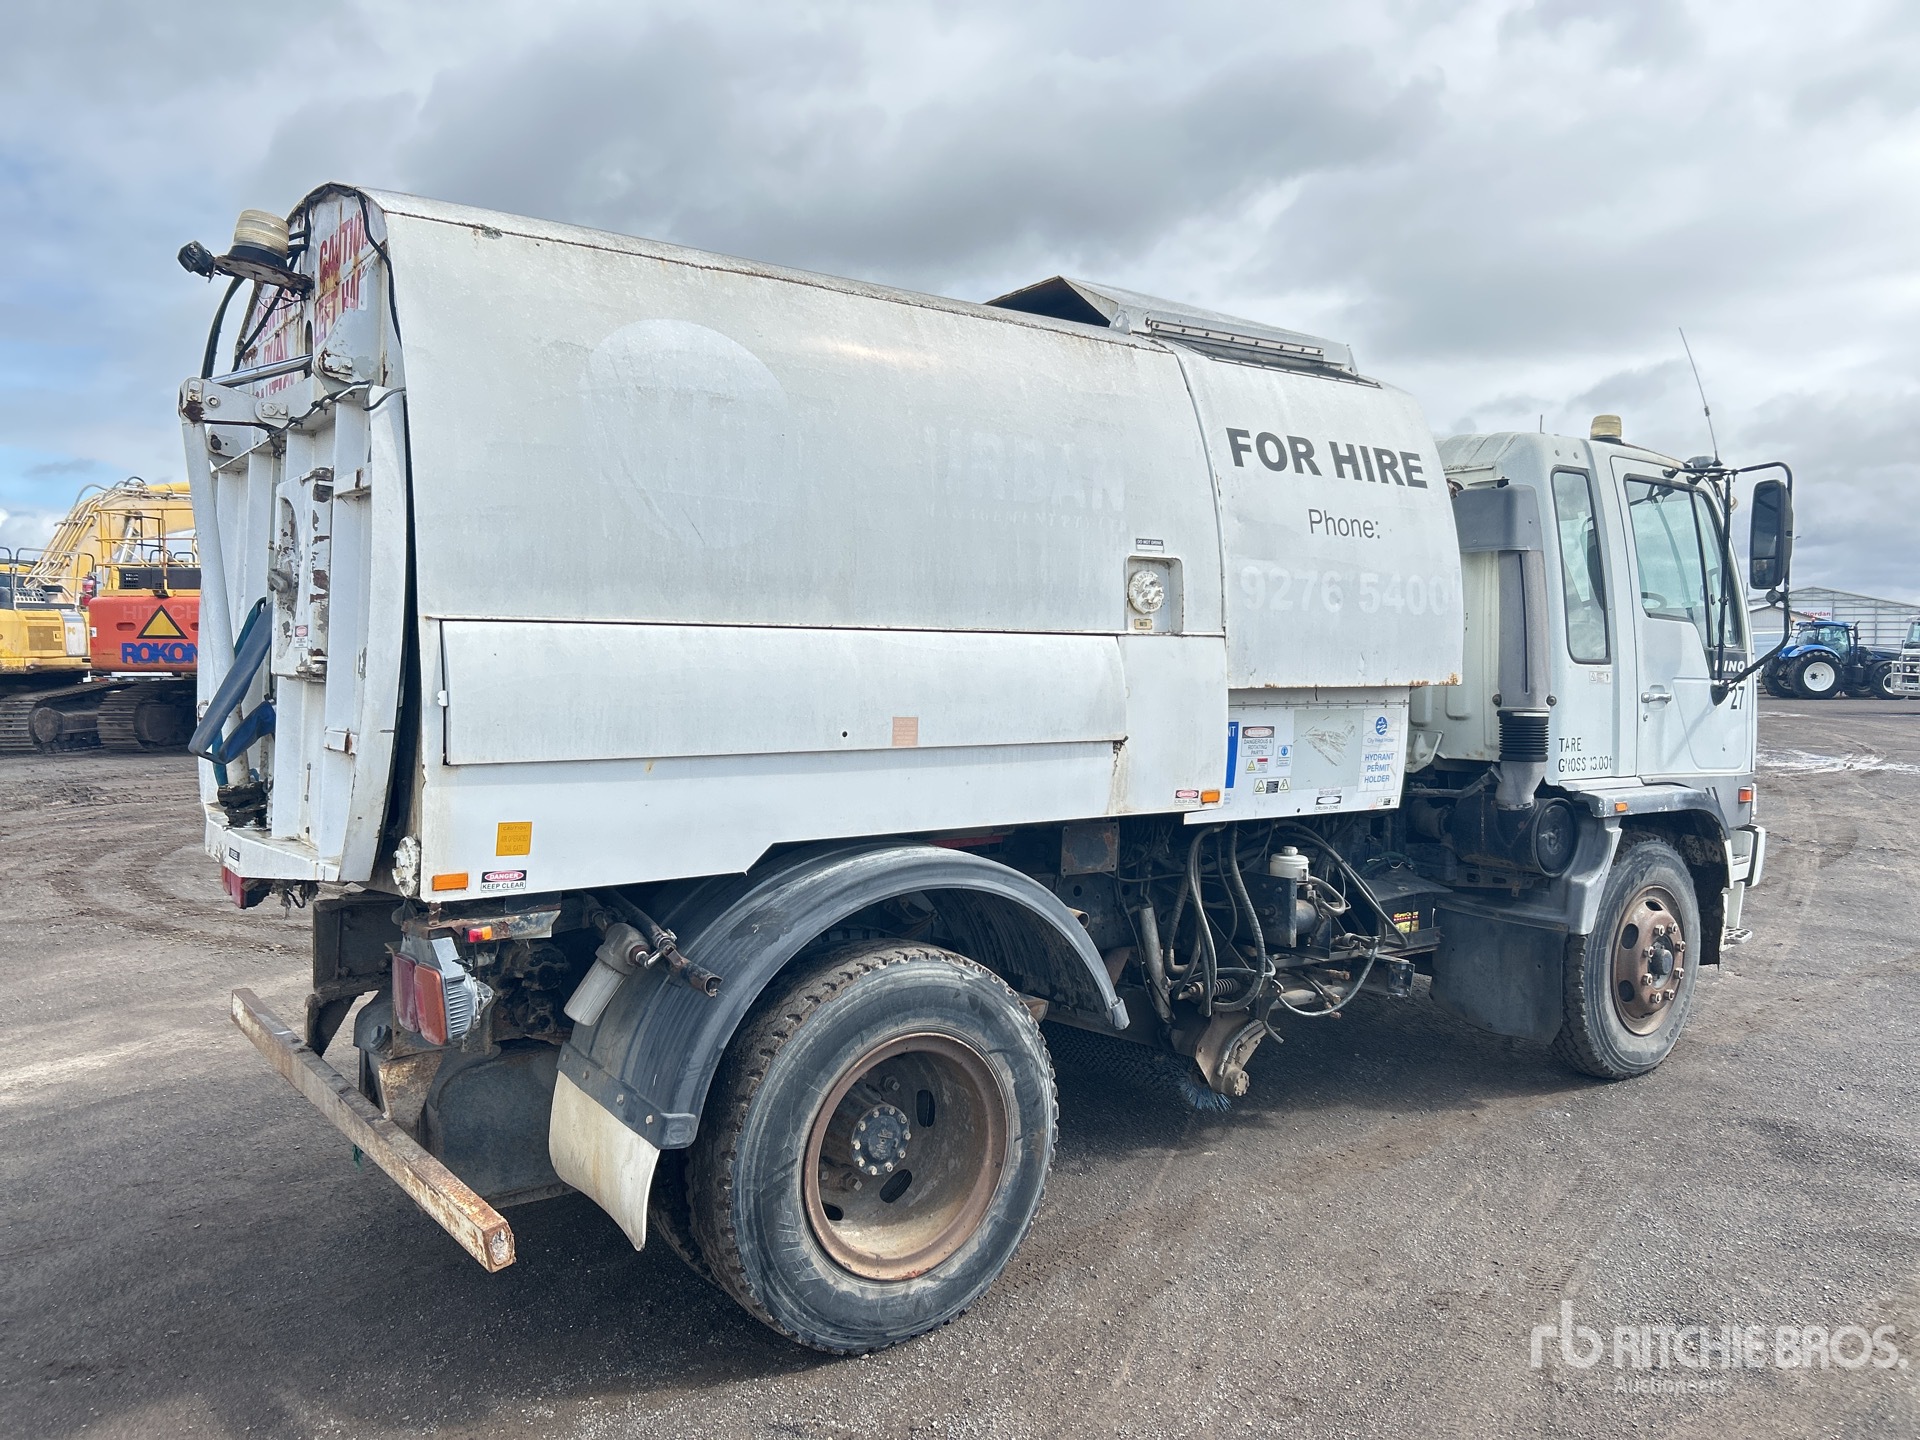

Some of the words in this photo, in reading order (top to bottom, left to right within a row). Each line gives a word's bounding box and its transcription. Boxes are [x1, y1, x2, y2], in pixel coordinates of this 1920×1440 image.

[1226, 427, 1323, 476] FOR
[1328, 441, 1428, 489] HIRE
[1308, 508, 1381, 539] Phone:
[1240, 565, 1343, 613] 9276
[1358, 572, 1449, 616] 5400
[122, 605, 200, 620] HITCH
[1730, 686, 1745, 710] 27
[1558, 737, 1582, 752] TARE
[1364, 753, 1395, 761] HYDRANT
[1558, 756, 1587, 772] GROSS
[1366, 764, 1391, 772] PERMIT
[1364, 774, 1391, 783] HOLDER
[489, 872, 519, 880] DANGER
[501, 881, 525, 889] CLEAR
